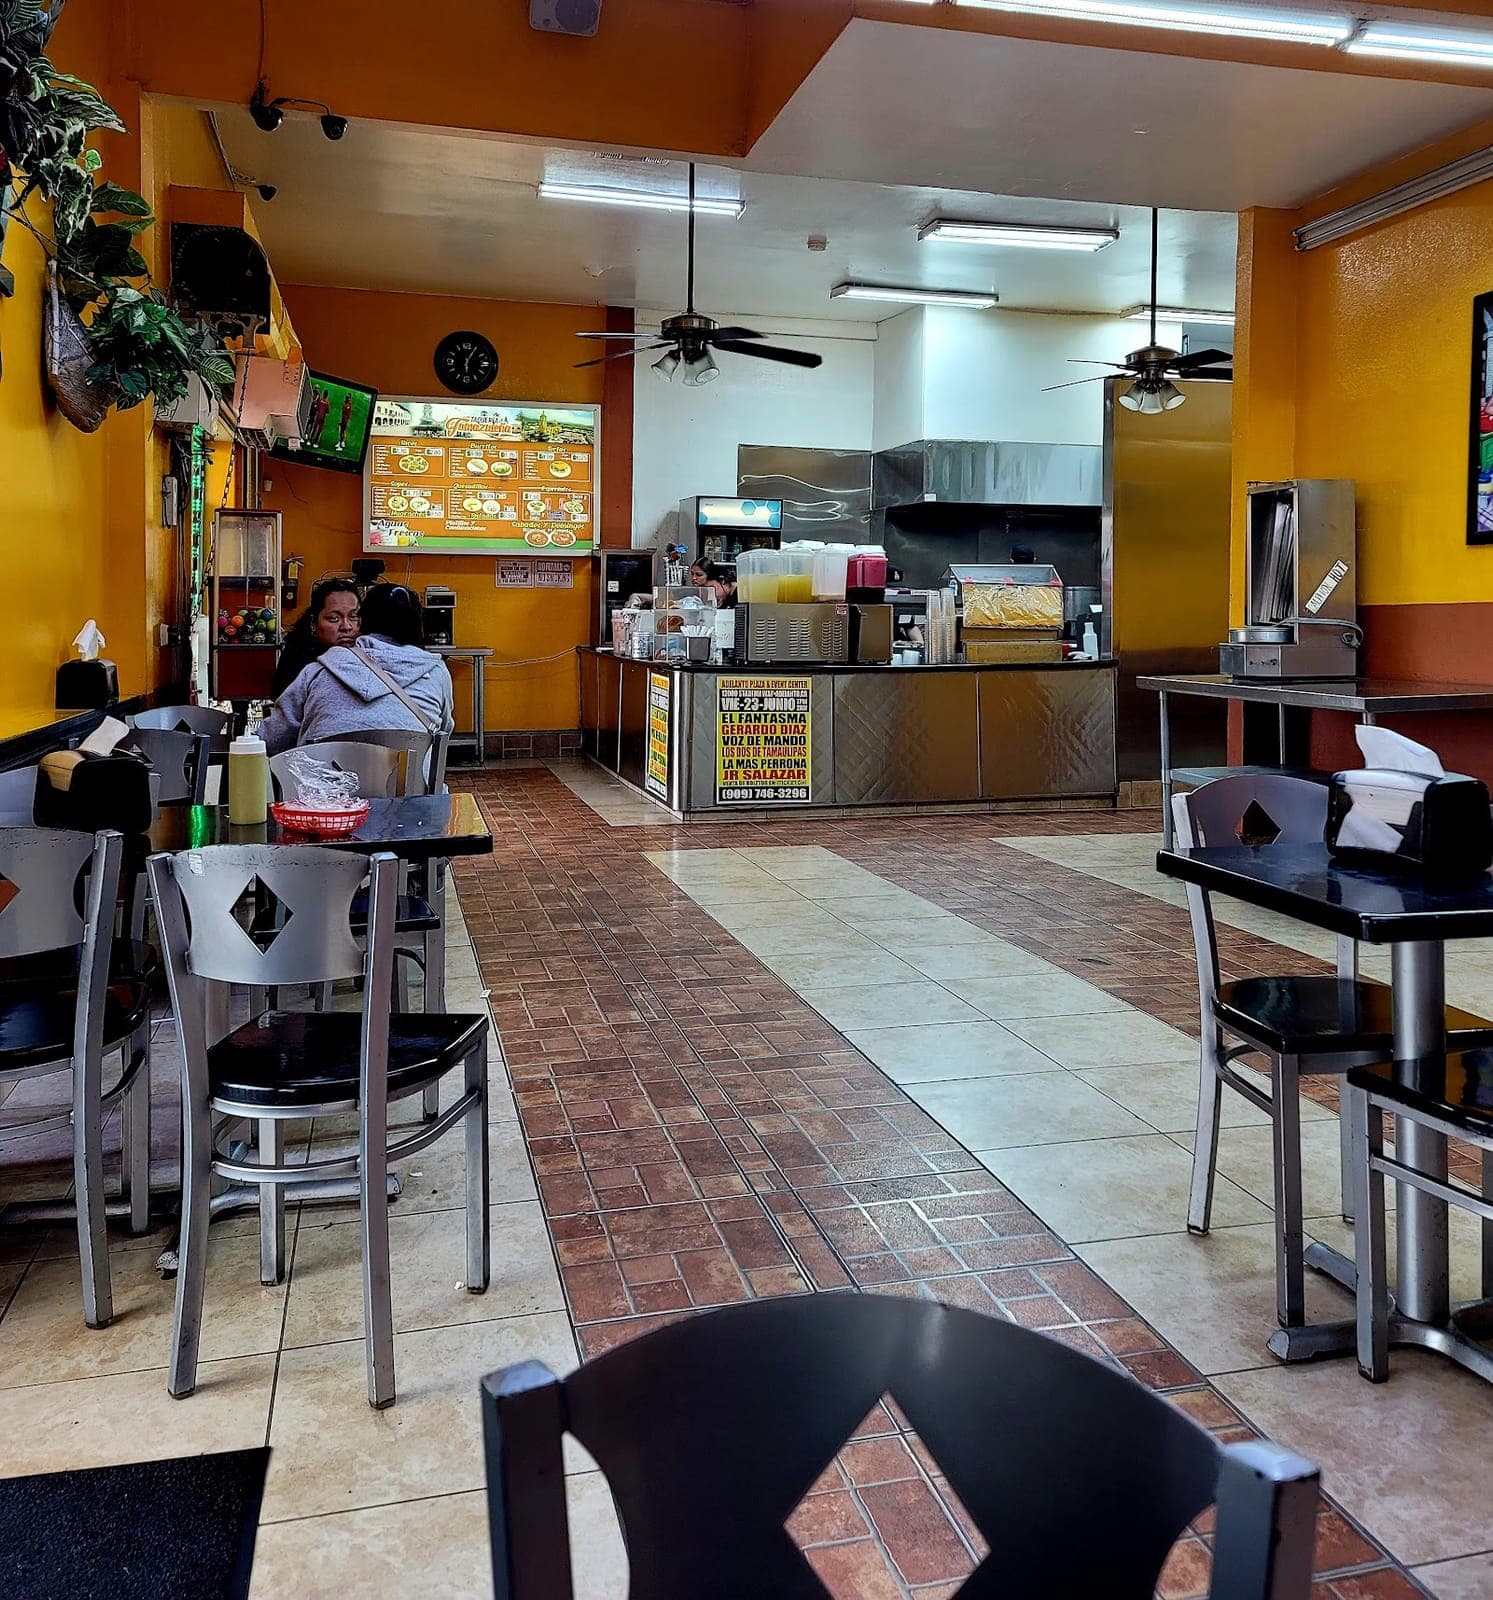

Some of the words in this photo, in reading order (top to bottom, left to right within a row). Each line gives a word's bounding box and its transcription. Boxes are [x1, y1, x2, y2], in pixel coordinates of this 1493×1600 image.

[378, 518, 409, 529] Aguas
[1328, 562, 1346, 584] HOT
[721, 680, 748, 689] ADELANTO
[749, 680, 766, 689] PLAZA
[771, 680, 787, 689] EVENT
[787, 680, 808, 689] CENTER
[721, 697, 796, 711] VIE-23-JUNIO
[722, 713, 735, 723] EL
[738, 713, 807, 723] FANTASMA
[721, 724, 777, 735] GERARDO
[780, 724, 807, 735] DIAZ
[722, 736, 744, 746] VOZ
[747, 736, 761, 746] DE
[763, 736, 807, 746] MANDO
[722, 747, 735, 757] LOS
[736, 747, 751, 757] DOS
[752, 747, 761, 757] DE
[762, 747, 807, 757] TAMAULIPAS
[722, 759, 734, 769] LA
[736, 759, 759, 769] MAS
[760, 759, 807, 769] PERRONA
[723, 769, 739, 780] JR
[742, 769, 807, 780] SALAZAR
[721, 788, 753, 799] (909)
[754, 788, 807, 799] 746-3296
